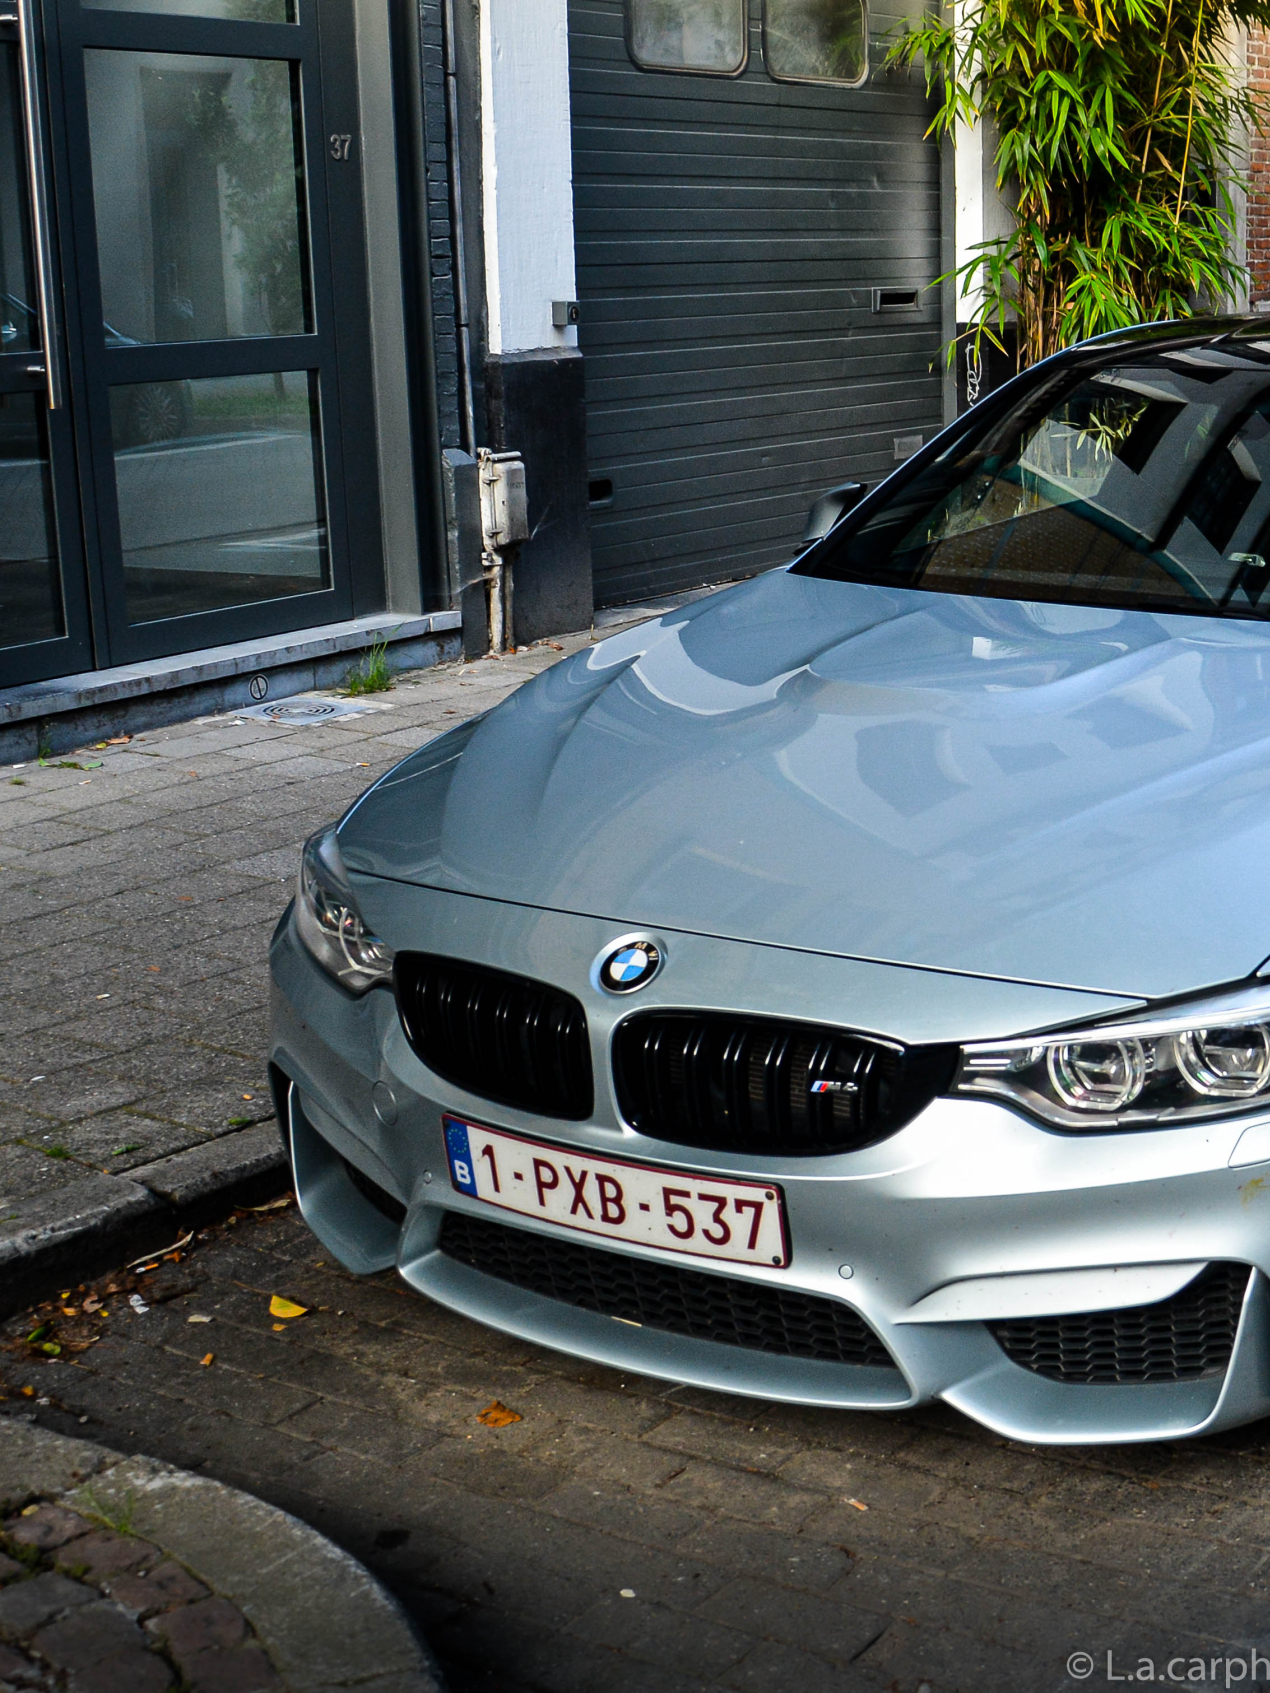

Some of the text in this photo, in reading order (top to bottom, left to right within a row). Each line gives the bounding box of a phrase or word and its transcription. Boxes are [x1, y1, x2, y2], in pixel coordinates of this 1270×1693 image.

[330, 134, 352, 160] 37
[454, 1159, 471, 1185] B
[482, 1144, 765, 1250] 1-PXB-537
